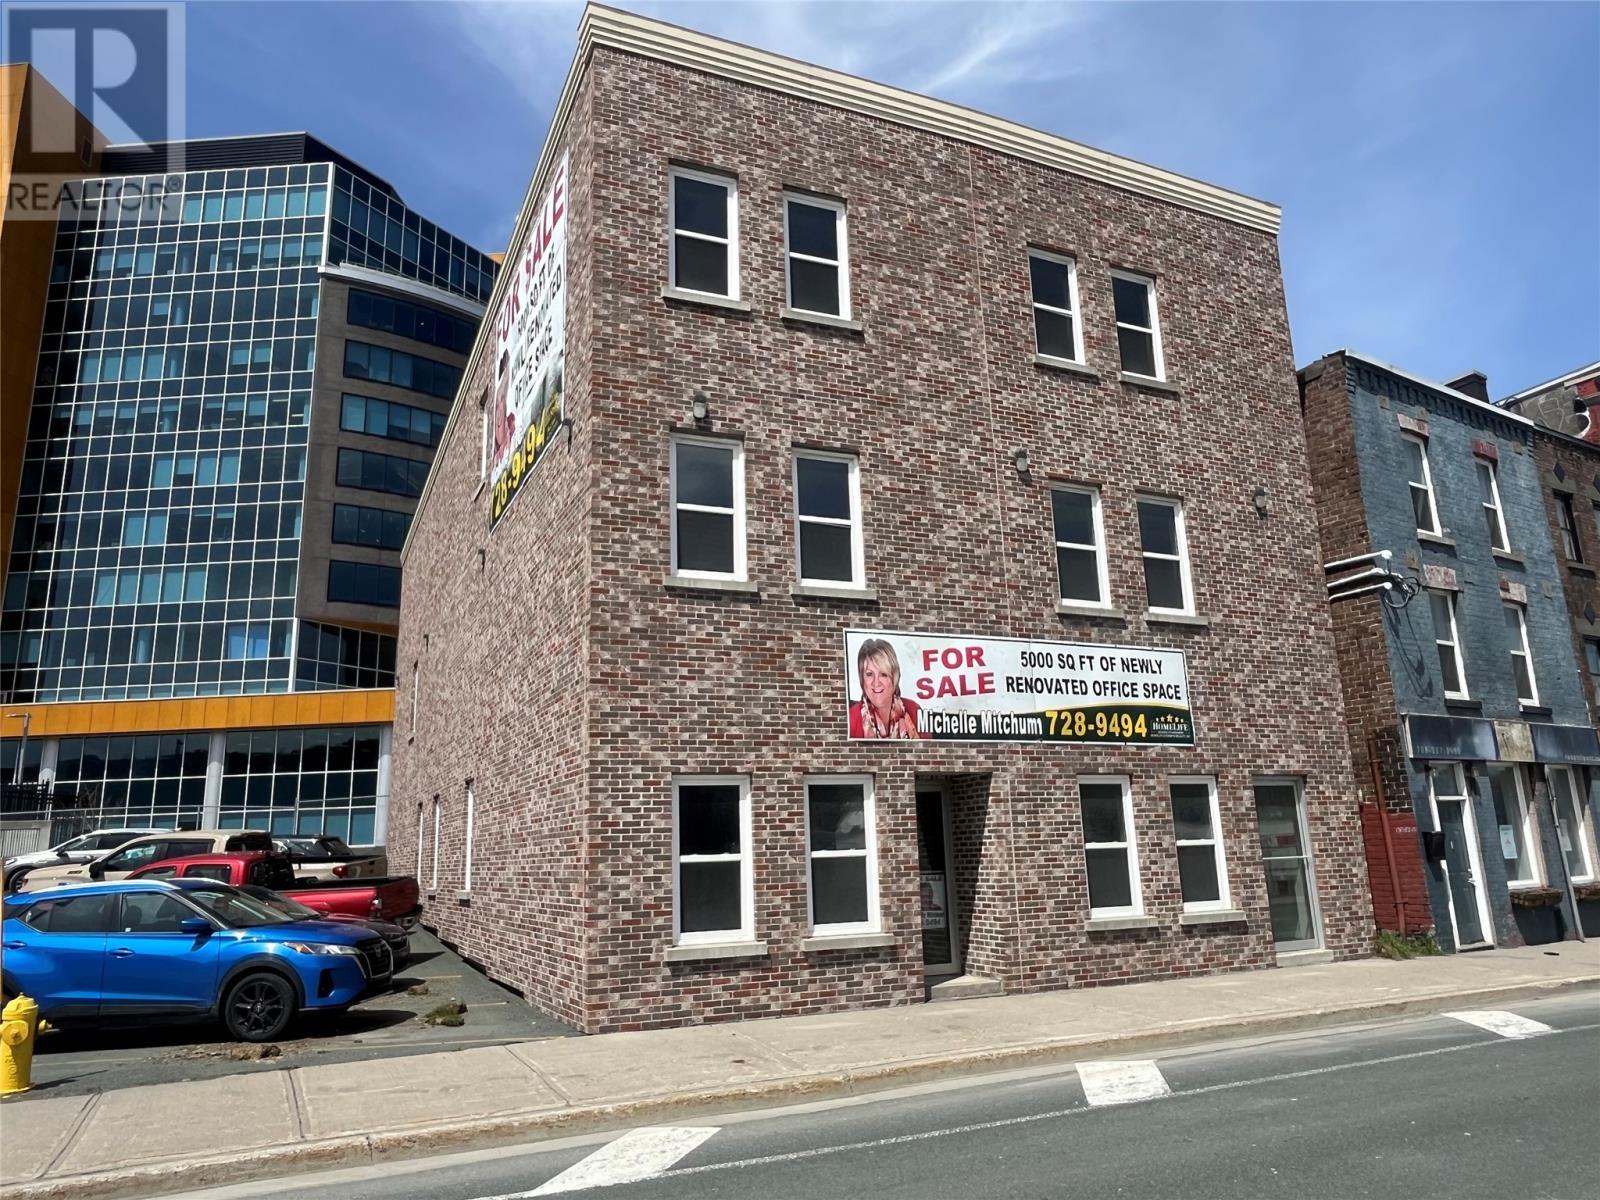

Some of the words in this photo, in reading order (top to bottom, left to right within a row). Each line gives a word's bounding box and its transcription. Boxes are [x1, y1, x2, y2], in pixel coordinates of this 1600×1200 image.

[496, 271, 521, 357] FOR
[525, 165, 564, 293] SALE
[922, 646, 987, 671] FOR
[1020, 650, 1054, 669] 5000
[1057, 653, 1076, 671] SQ
[1079, 655, 1095, 671] FT
[1099, 656, 1116, 672] OF
[1120, 657, 1162, 675] NEWLY
[916, 672, 996, 700] SALE
[1005, 676, 1089, 696] RENOVATED
[1092, 680, 1140, 698] OFFICE
[1142, 682, 1182, 701] SPACE
[916, 708, 977, 734] Michelle
[980, 709, 1043, 735] Mitchum
[1045, 710, 1148, 738] 728-9494
